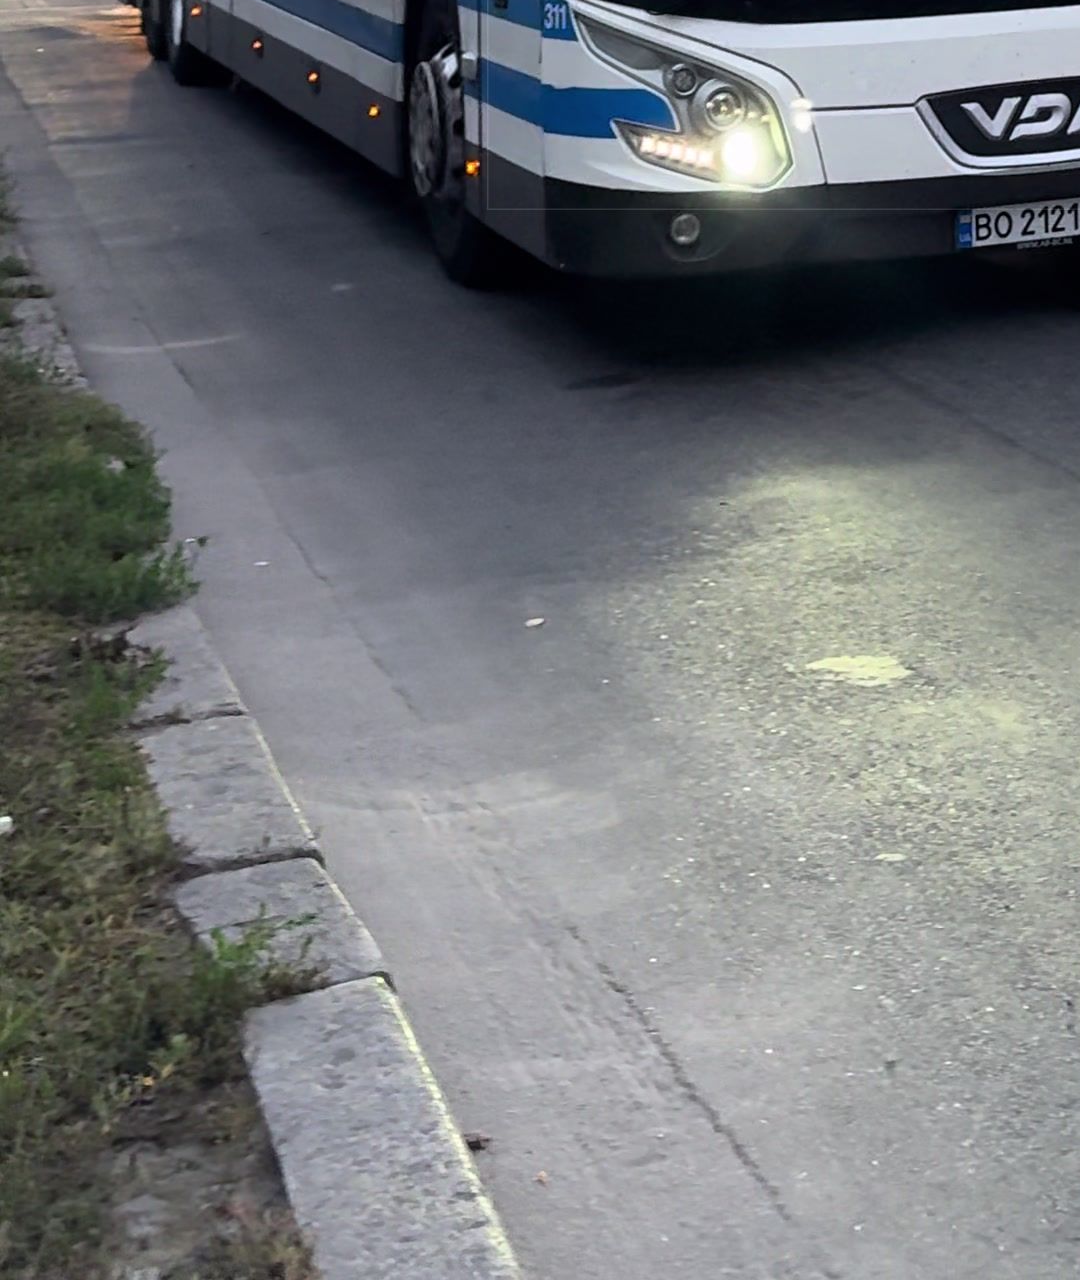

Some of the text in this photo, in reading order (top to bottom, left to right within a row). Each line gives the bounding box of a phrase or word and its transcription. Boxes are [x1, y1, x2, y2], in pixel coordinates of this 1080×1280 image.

[543, 2, 567, 29] 311
[974, 211, 1013, 241] BO
[1020, 202, 1079, 236] 2121
